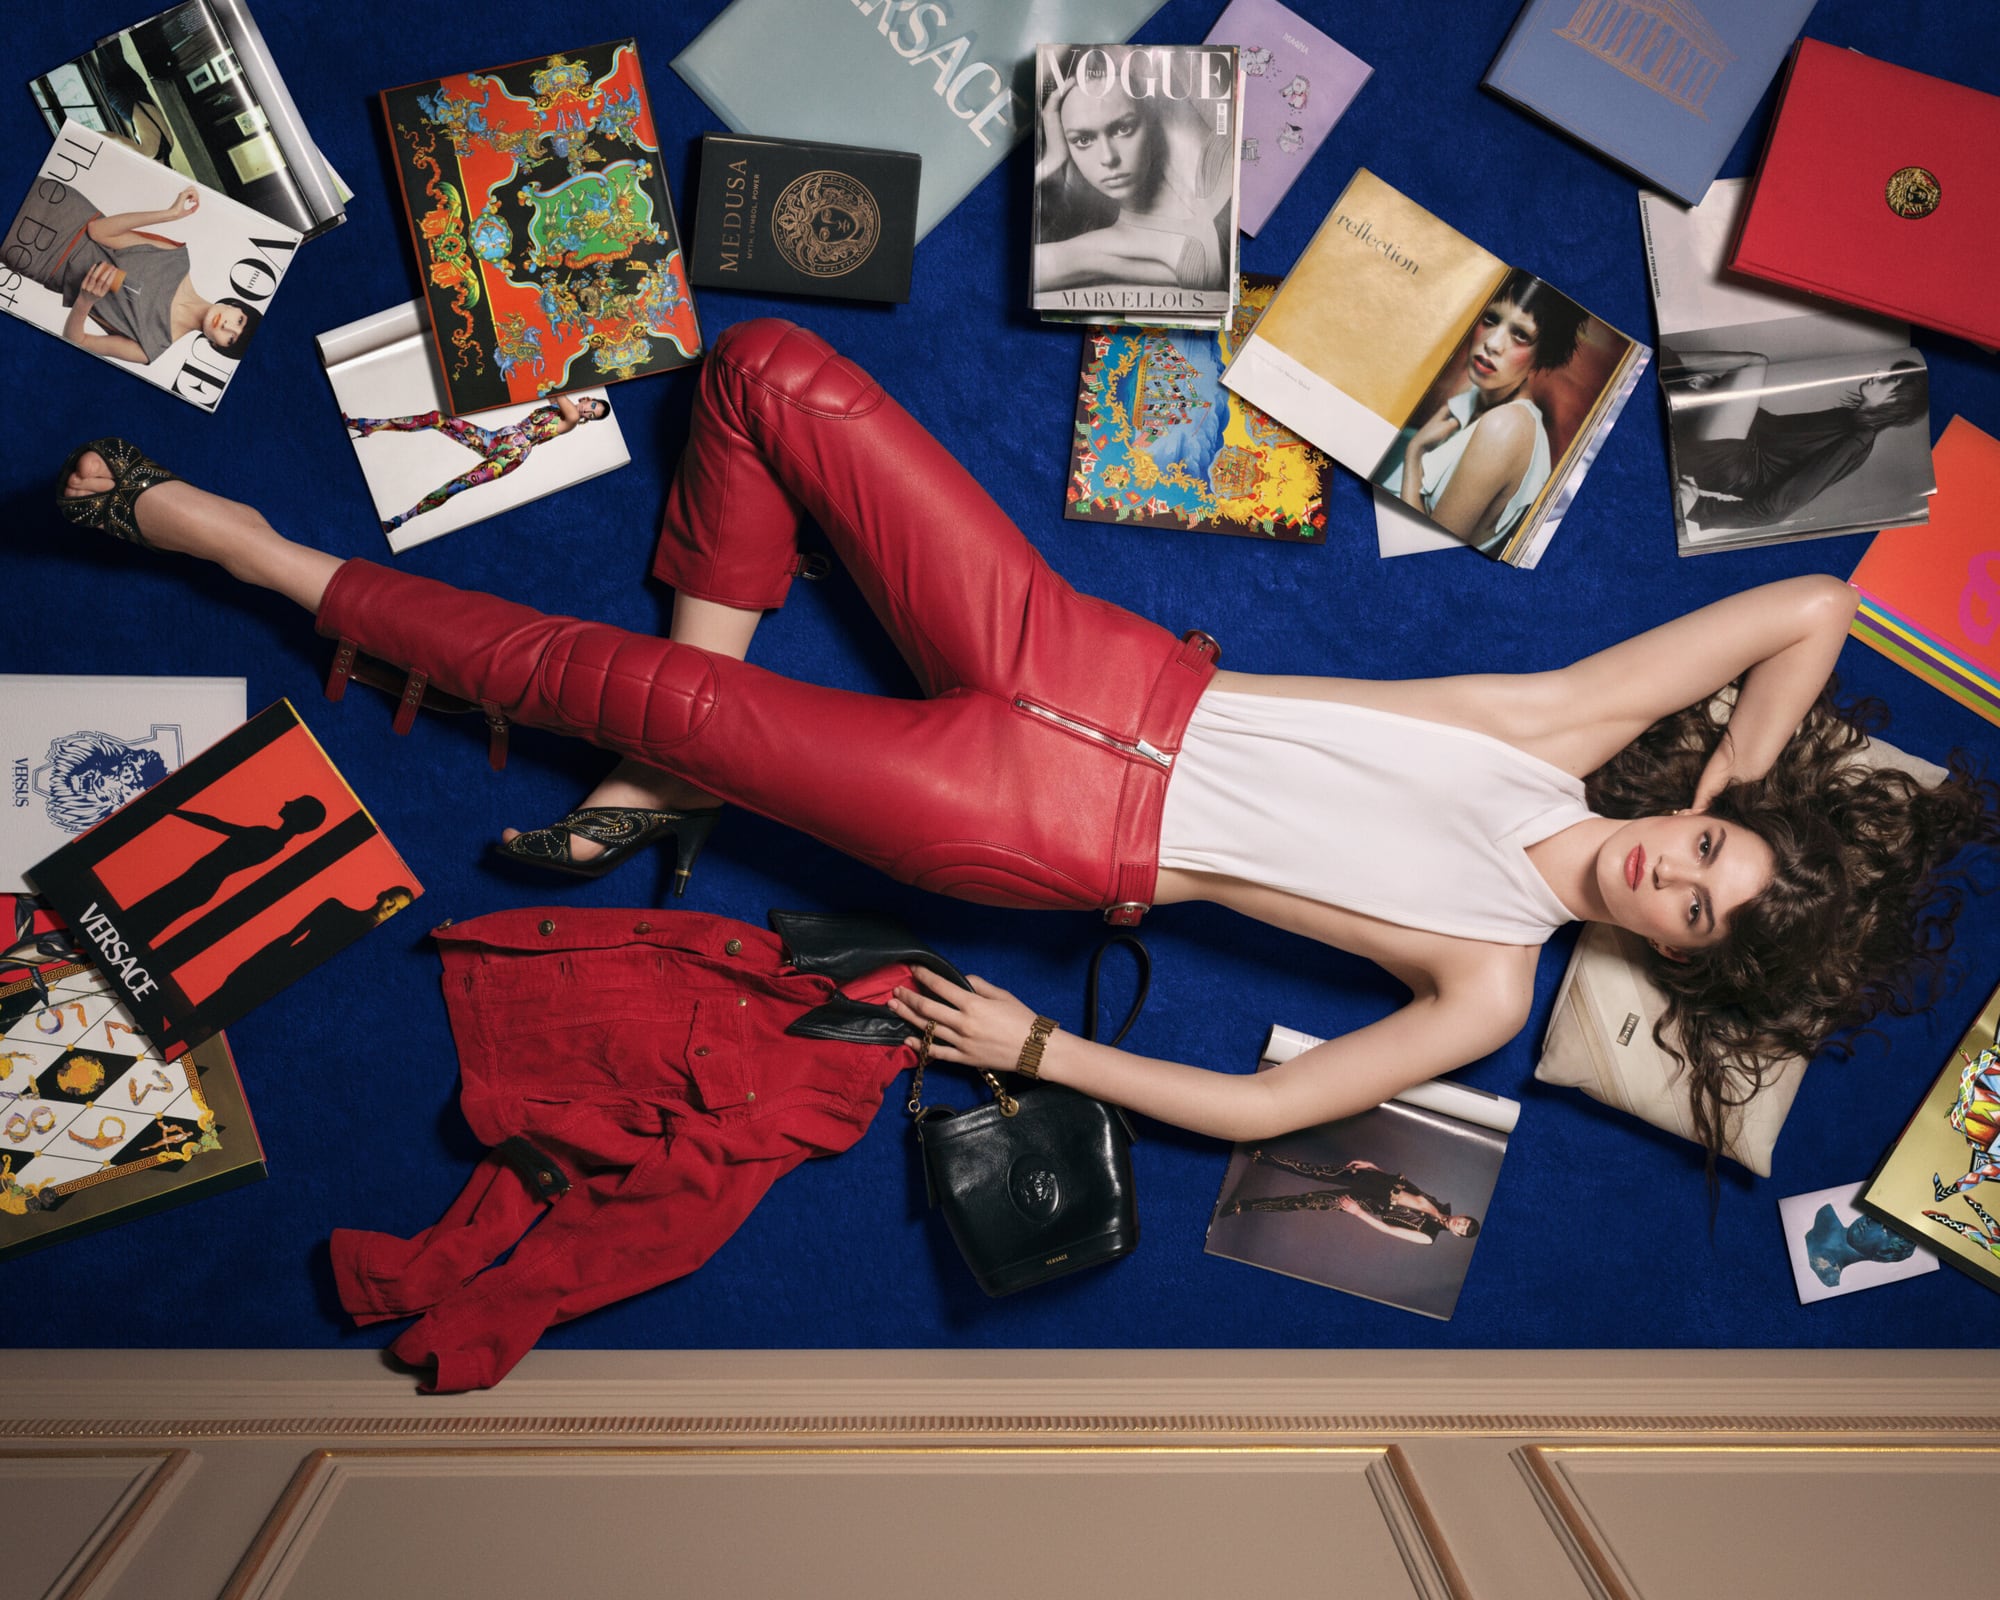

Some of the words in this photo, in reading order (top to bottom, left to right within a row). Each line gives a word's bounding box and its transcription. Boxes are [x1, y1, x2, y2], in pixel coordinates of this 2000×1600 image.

[1046, 49, 1232, 100] VOGUE
[38, 138, 104, 205] The
[752, 174, 760, 200] POWER
[720, 159, 747, 272] MEDUSA
[1336, 214, 1421, 276] reflection
[0, 216, 58, 308] Best
[247, 269, 260, 290] ITALIA
[171, 237, 298, 410] VOUE
[1062, 291, 1205, 309] MARVELLOUS
[15, 757, 29, 808] VERSUS
[79, 902, 159, 1002] VERSACE
